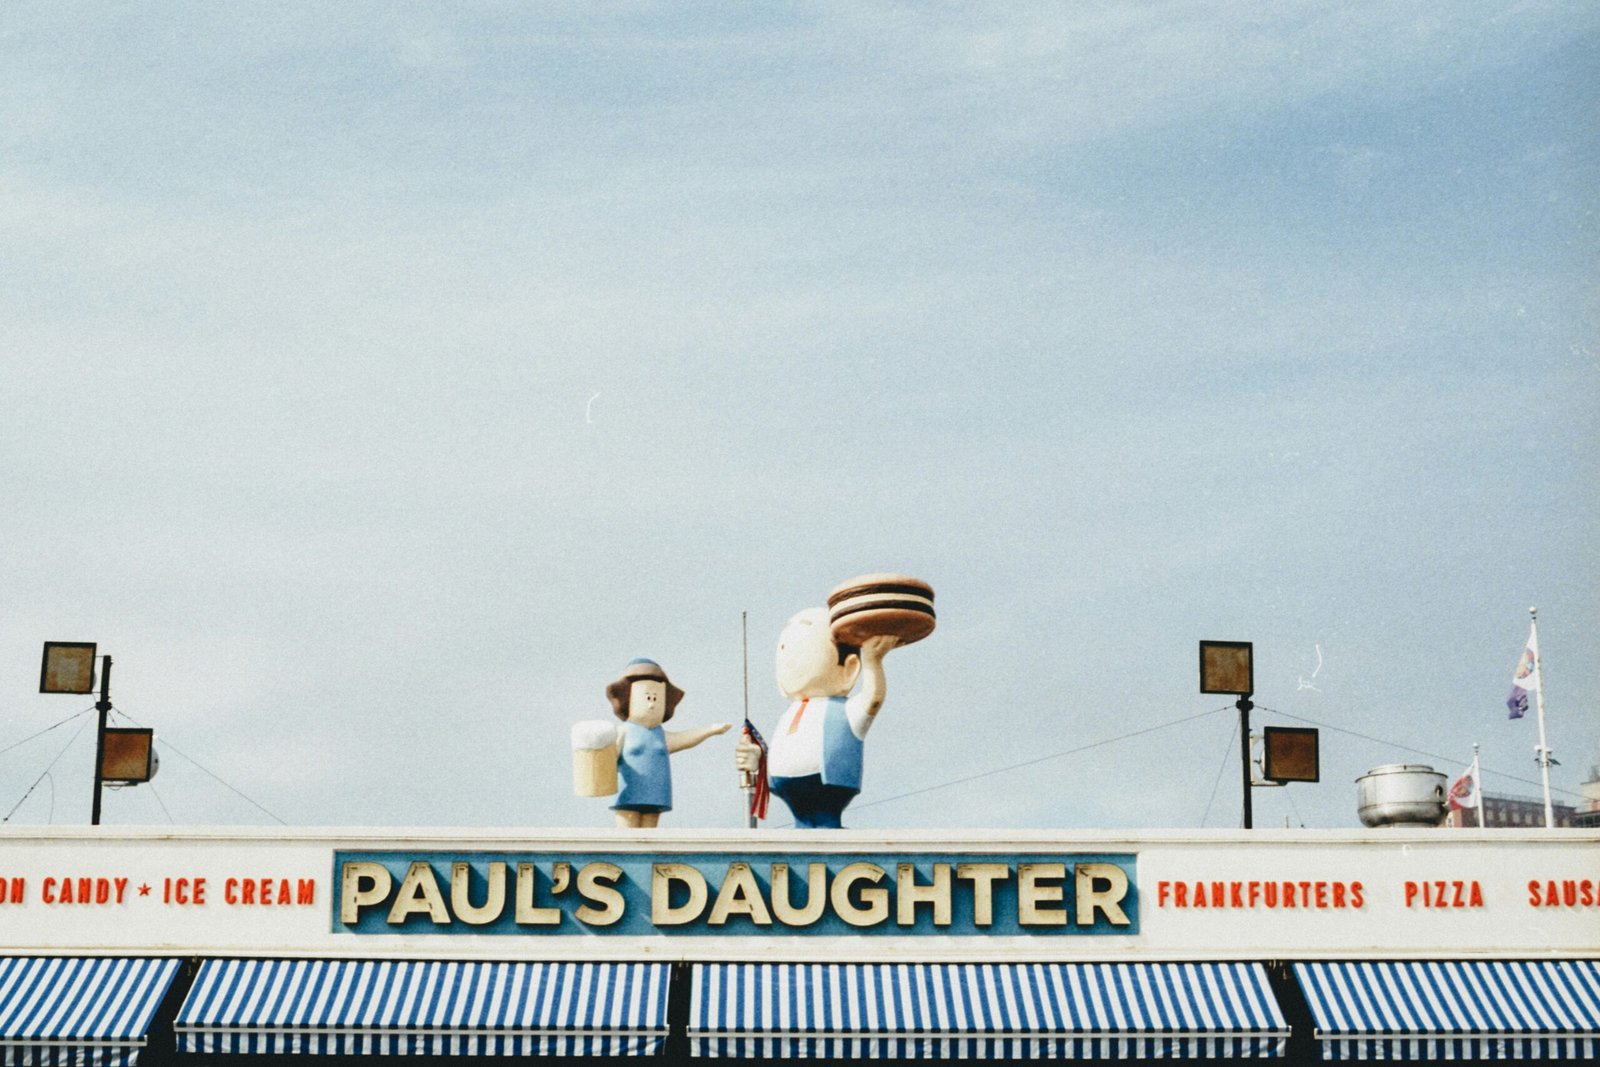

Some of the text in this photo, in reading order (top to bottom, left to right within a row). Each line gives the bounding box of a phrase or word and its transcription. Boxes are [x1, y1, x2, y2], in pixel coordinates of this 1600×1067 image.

[42, 877, 128, 905] CANDY
[163, 877, 206, 906] ICE
[224, 877, 315, 906] CREAM
[342, 863, 1130, 925] PAUL'S DAUGHTER
[1157, 880, 1600, 909] FRANKFURTERS PIZZA SAUS
